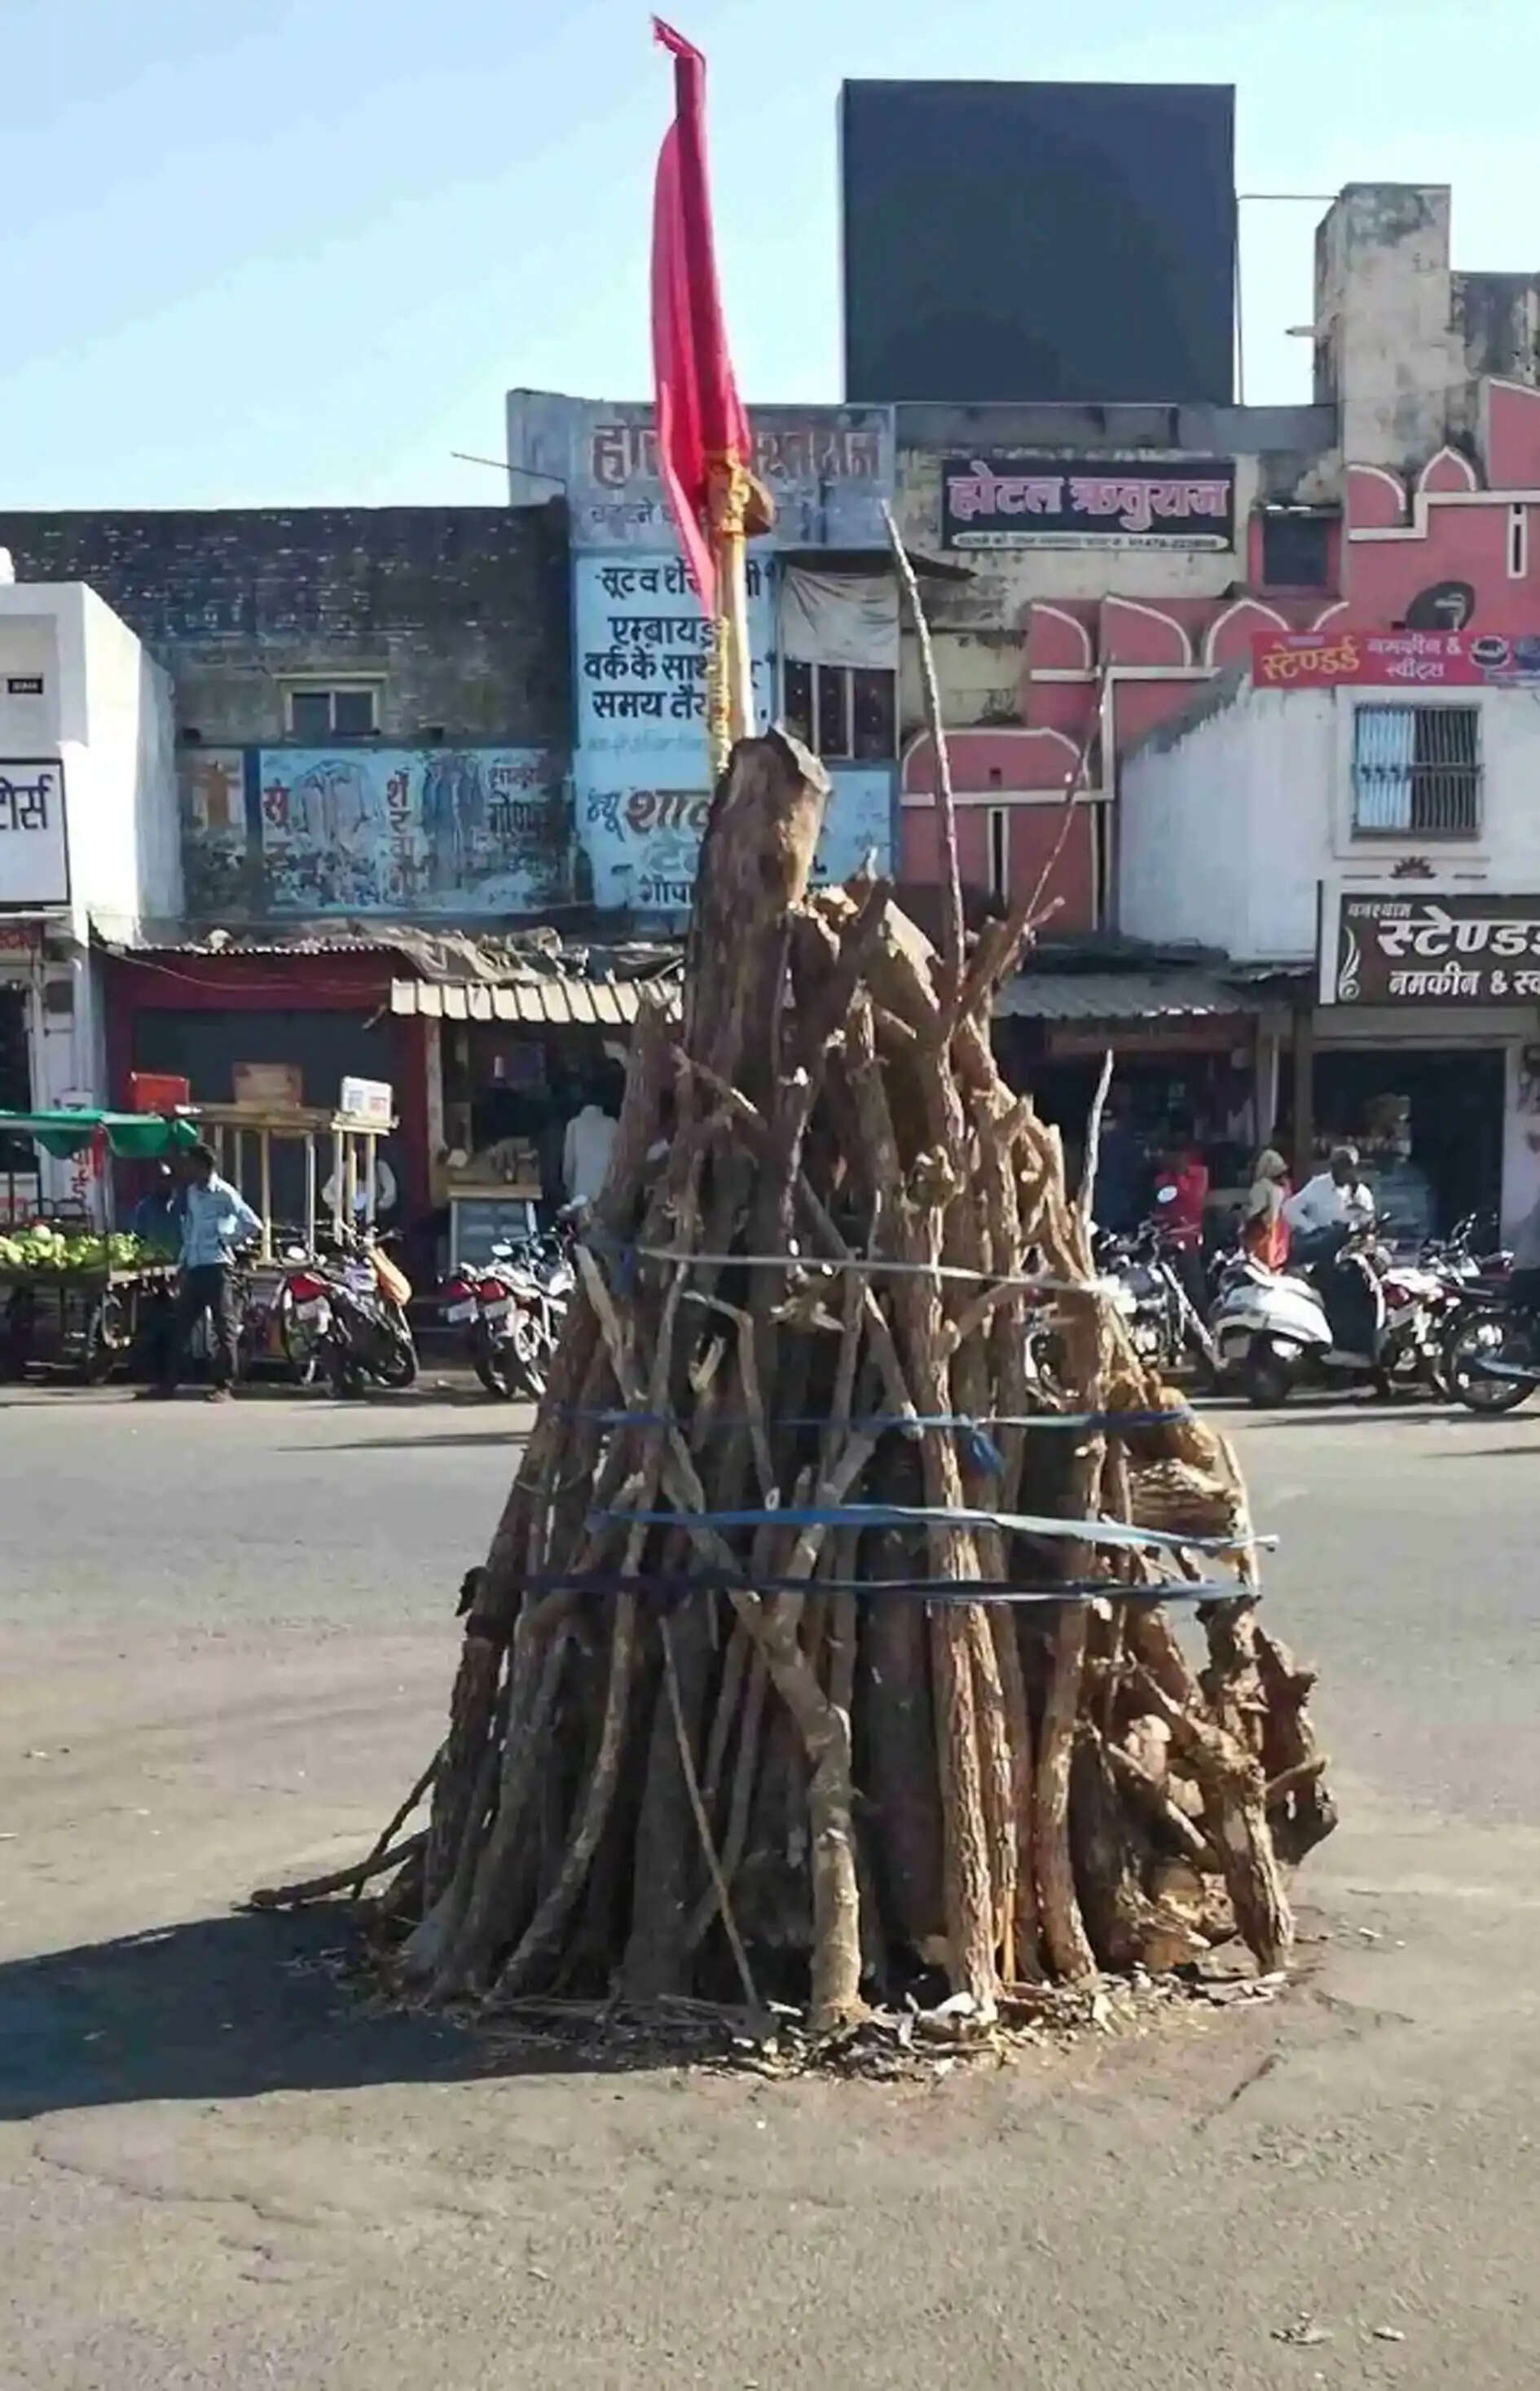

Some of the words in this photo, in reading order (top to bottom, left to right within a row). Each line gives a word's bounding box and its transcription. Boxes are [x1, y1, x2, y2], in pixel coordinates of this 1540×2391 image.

[948, 460, 1063, 521] होटल
[1069, 477, 1230, 531] ऋतुराज
[583, 646, 628, 680] वर्क
[631, 646, 657, 680] के
[592, 691, 667, 719] समय
[1378, 905, 1540, 957] स्टेण्ड
[1388, 960, 1482, 996] नमकीन
[1490, 970, 1508, 995] &
[1514, 971, 1540, 995] स्व
